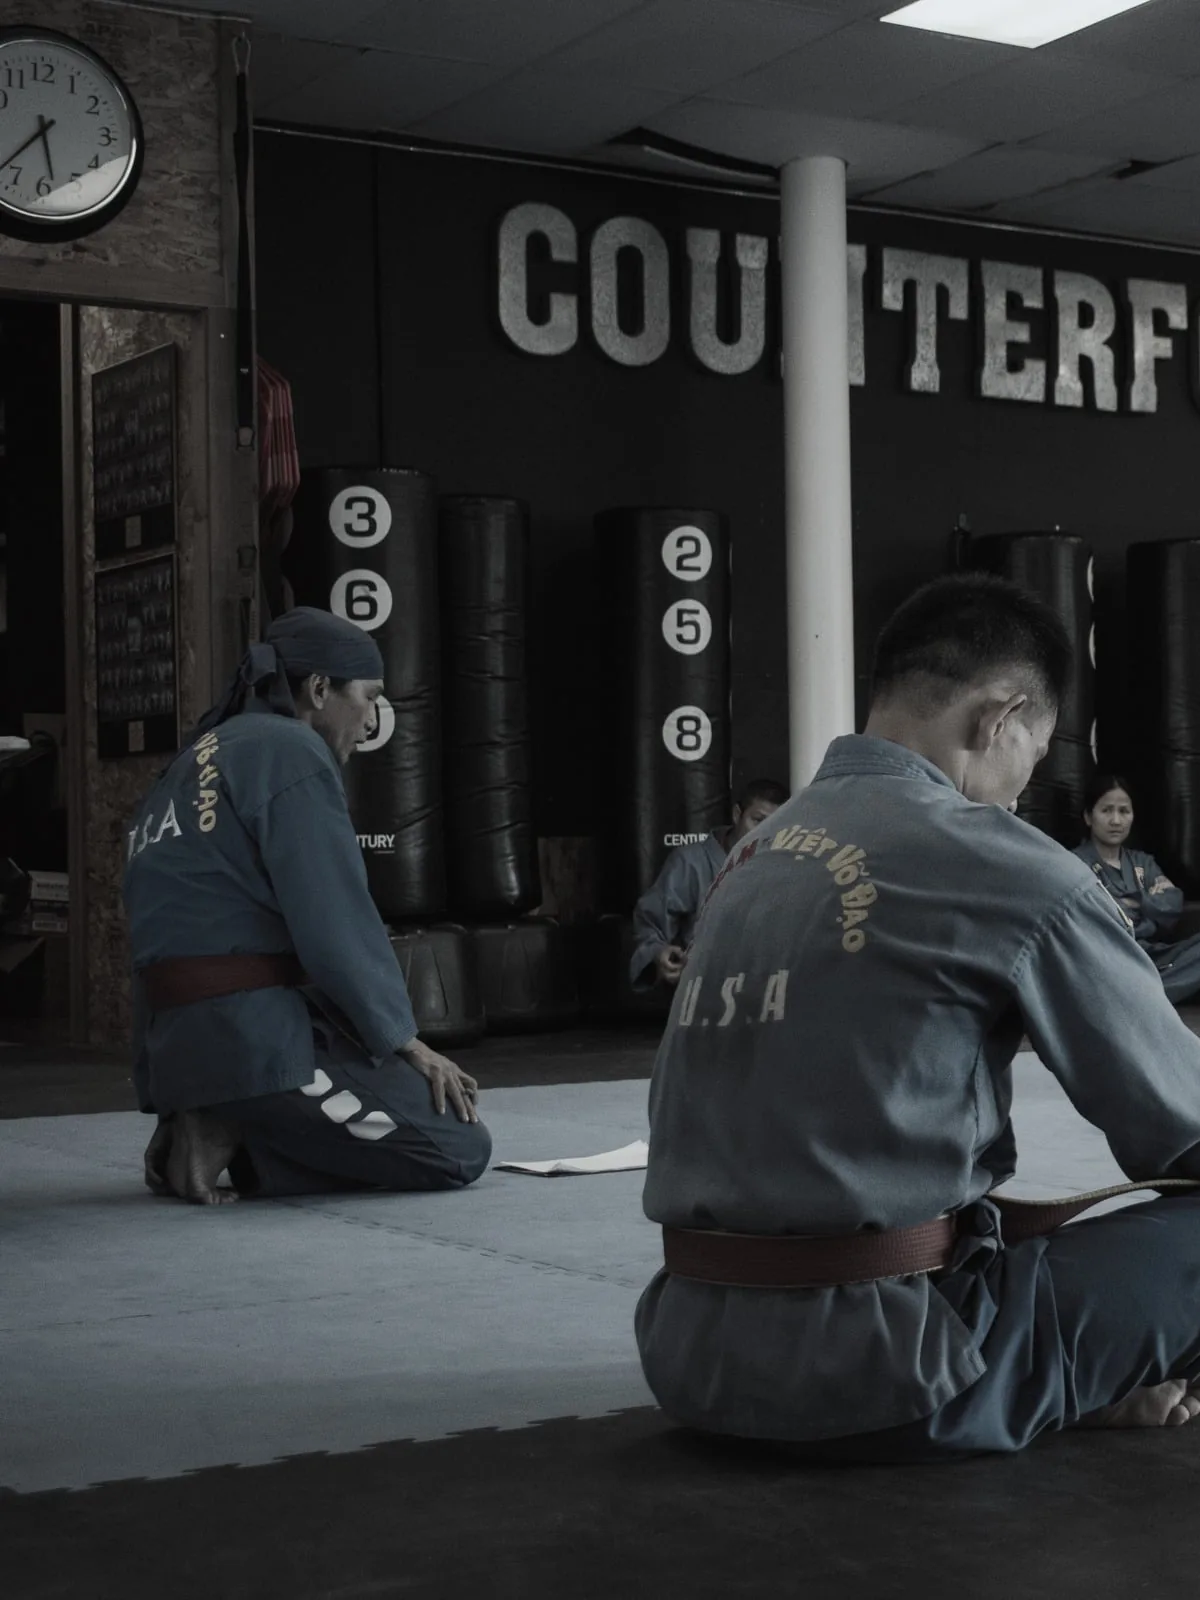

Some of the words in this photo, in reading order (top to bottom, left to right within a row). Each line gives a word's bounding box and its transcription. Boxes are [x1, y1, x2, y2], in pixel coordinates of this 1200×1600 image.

[6, 68, 25, 89] 11
[31, 62, 55, 84] 12
[68, 75, 77, 94] 1
[86, 95, 99, 115] 2
[98, 127, 112, 146] 3
[88, 155, 99, 170] 4
[9, 166, 22, 186] 7
[36, 176, 51, 197] 6
[344, 496, 377, 537] 3
[676, 535, 701, 572] 2
[346, 580, 378, 621] 6
[676, 608, 700, 645] 5
[676, 715, 701, 752] 8
